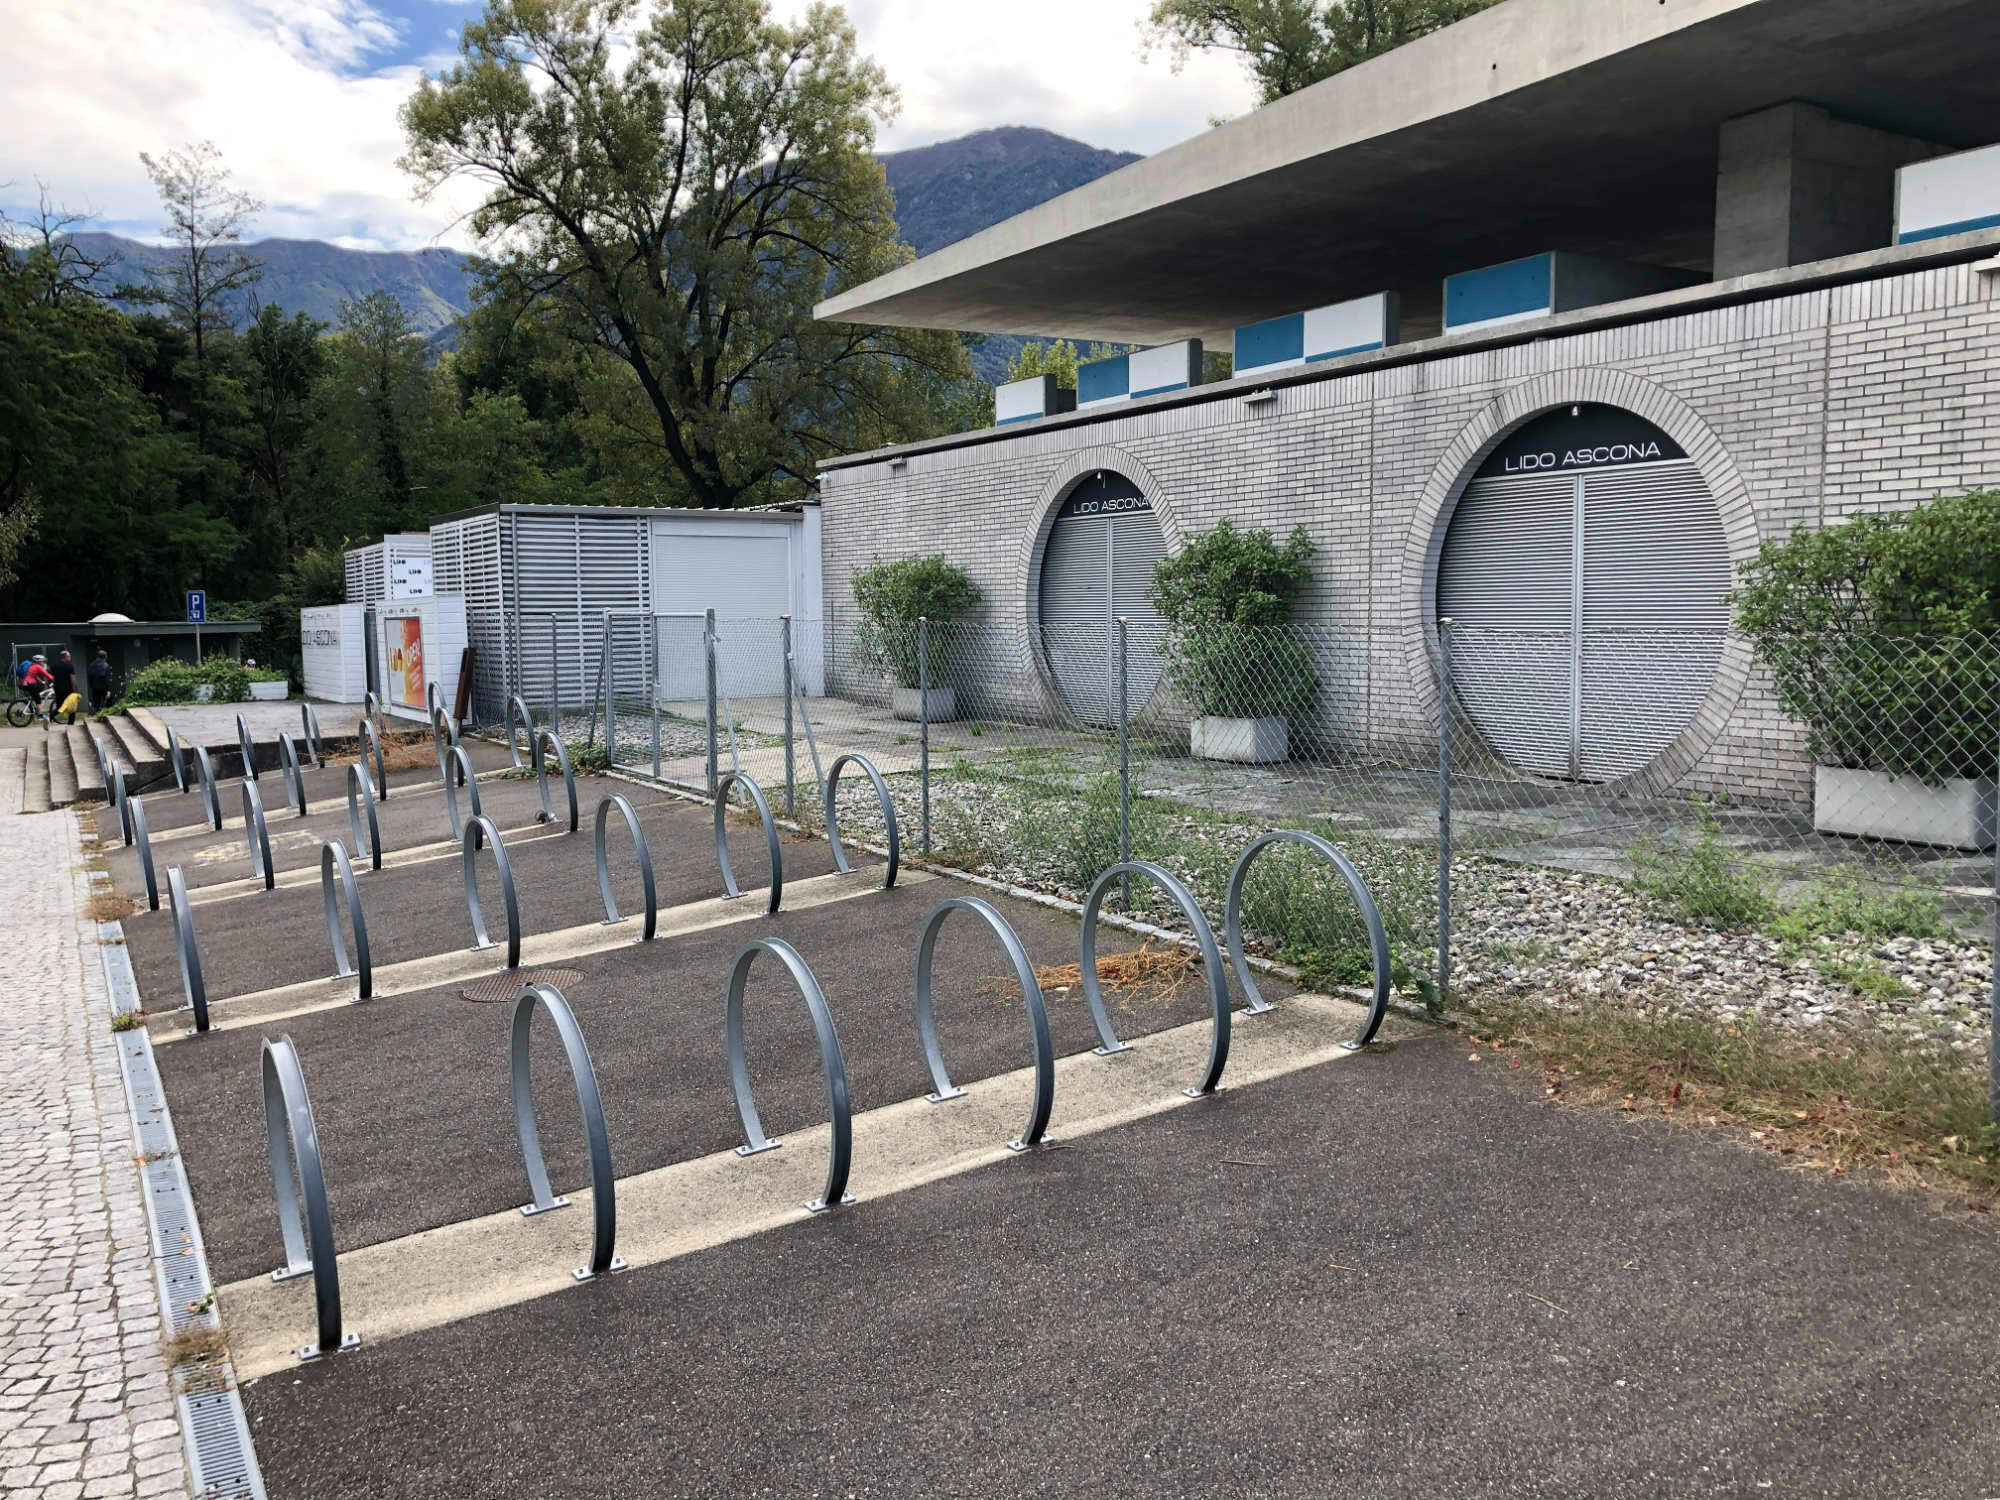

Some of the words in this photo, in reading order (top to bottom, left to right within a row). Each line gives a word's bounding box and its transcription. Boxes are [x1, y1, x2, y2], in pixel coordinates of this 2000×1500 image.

[1505, 452, 1555, 472] LIDO
[1562, 441, 1661, 465] ASCONA
[1073, 501, 1098, 514] LIDO
[1101, 496, 1149, 511] ASCONA
[192, 594, 200, 609] P
